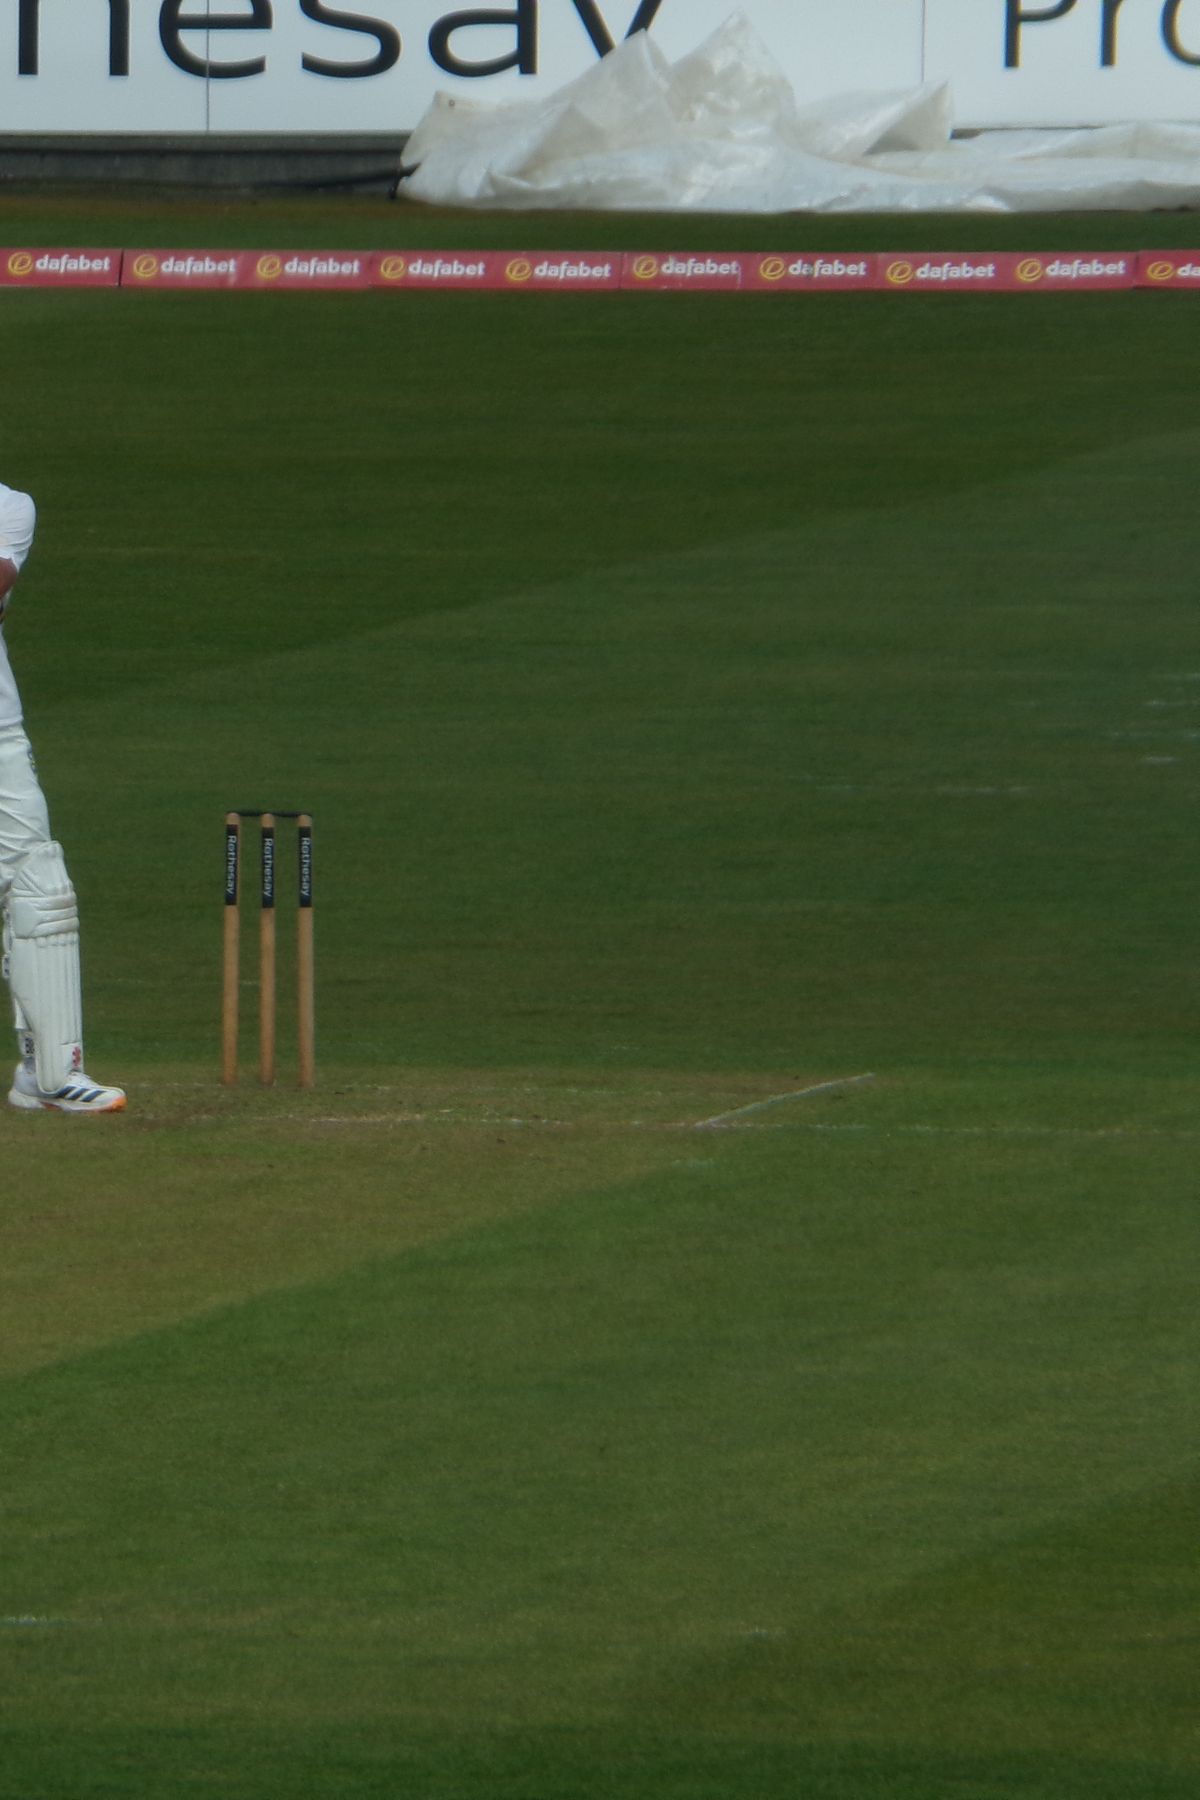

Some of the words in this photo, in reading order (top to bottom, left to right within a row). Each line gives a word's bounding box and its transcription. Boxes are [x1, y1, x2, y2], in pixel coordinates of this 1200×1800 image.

[36, 254, 110, 272] dafabet
[161, 257, 236, 275] dafabet
[285, 258, 360, 276] dafabet
[409, 259, 485, 278] dafabet
[534, 261, 611, 280] dafabet
[661, 257, 738, 276] dafabet
[788, 260, 866, 277] dafabet
[916, 263, 995, 280] dafabet
[1046, 260, 1125, 278] dafabet
[226, 835, 236, 895] Rothesay
[264, 838, 273, 897] Rothesay
[300, 837, 310, 896] Rothesay
